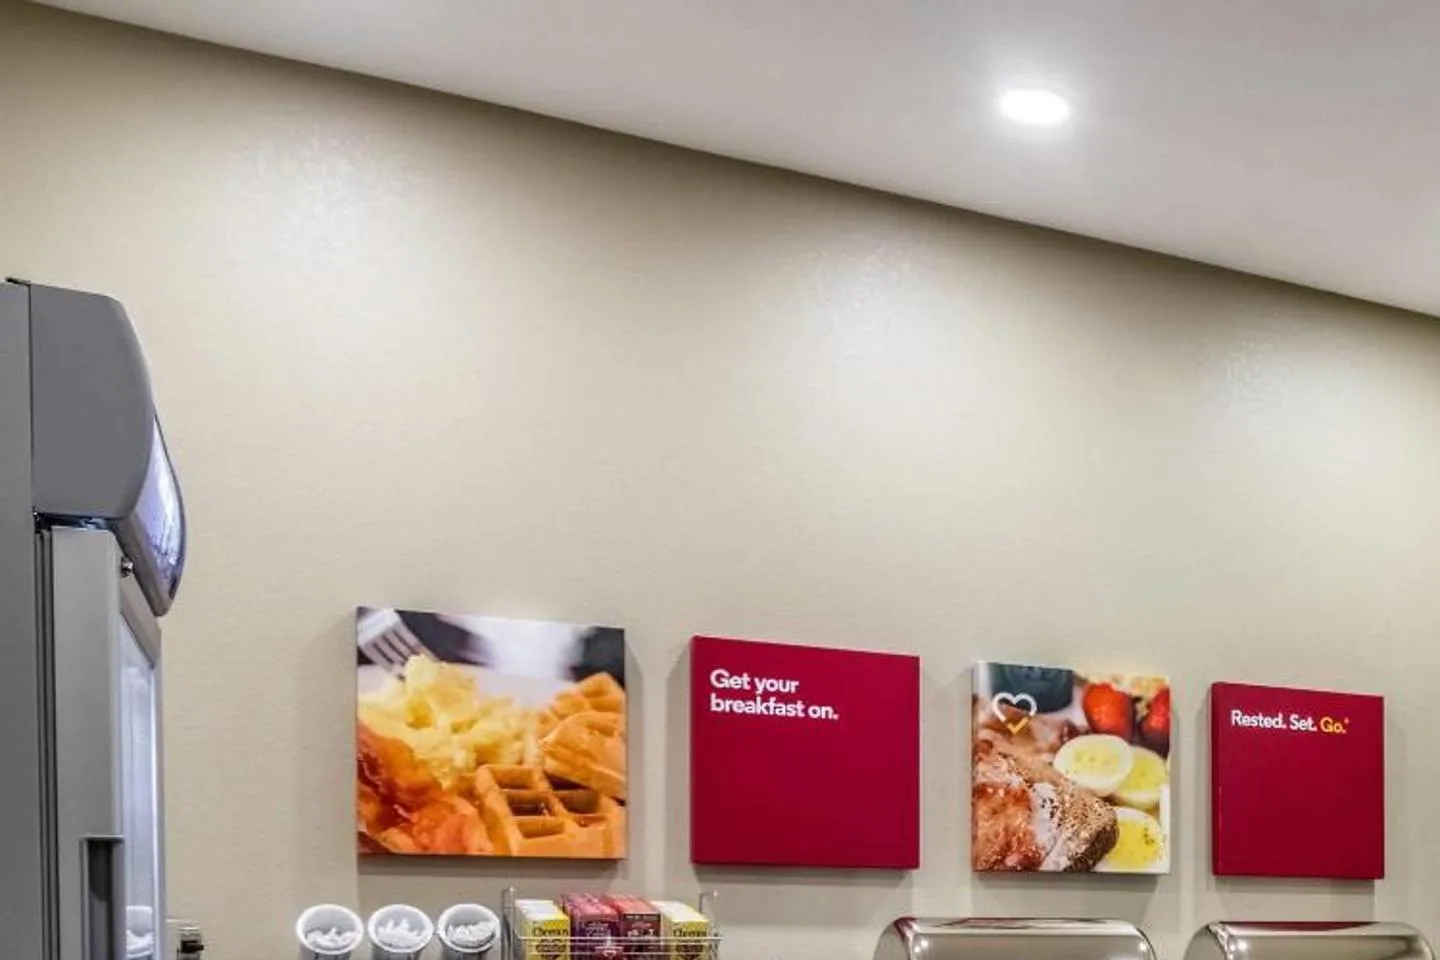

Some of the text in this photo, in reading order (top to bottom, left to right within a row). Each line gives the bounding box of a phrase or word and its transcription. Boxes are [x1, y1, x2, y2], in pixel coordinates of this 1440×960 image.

[709, 668, 800, 694] Get your
[709, 693, 840, 720] breakfast on.
[1230, 709, 1287, 729] Rested.
[1289, 713, 1318, 732] Set.
